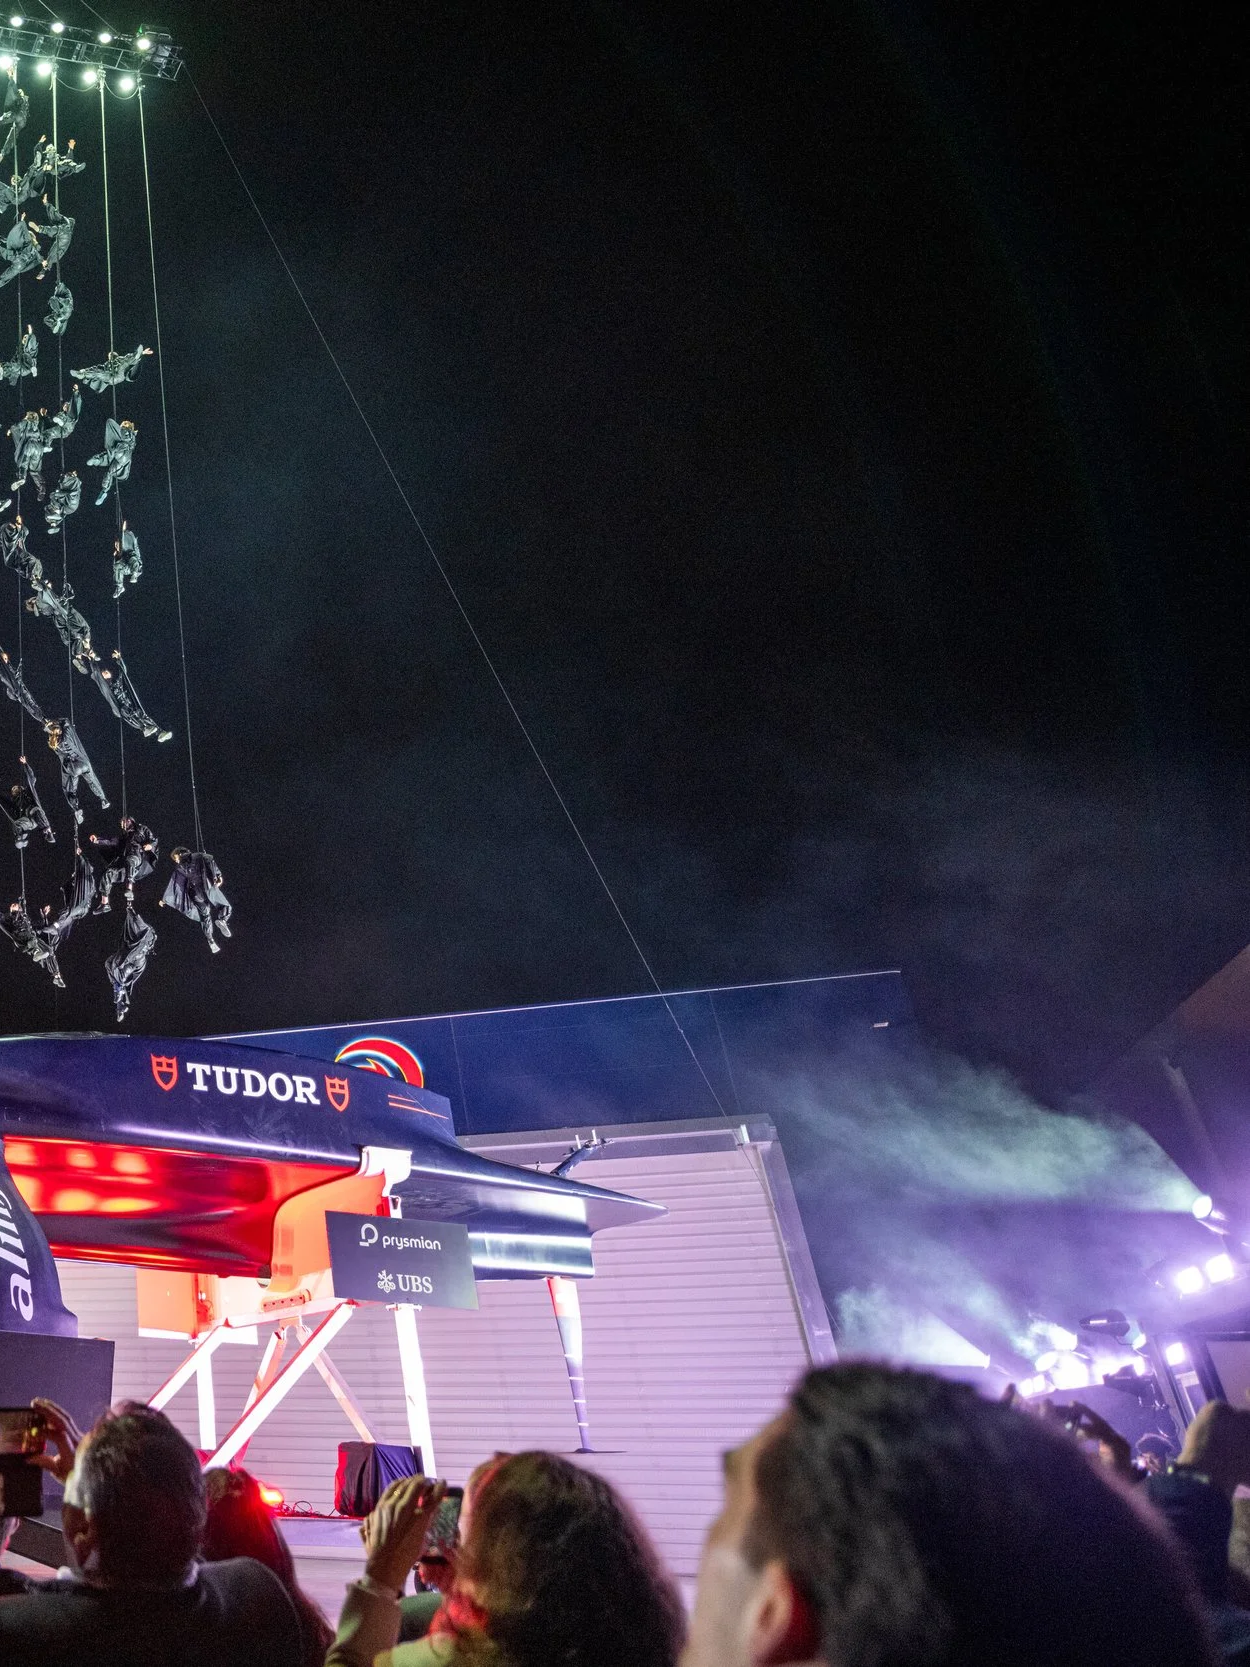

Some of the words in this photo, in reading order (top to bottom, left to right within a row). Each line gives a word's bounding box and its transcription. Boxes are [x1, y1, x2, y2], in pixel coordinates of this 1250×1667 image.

[187, 1062, 321, 1105] TUDOR
[382, 1235, 442, 1251] prysmian
[396, 1273, 433, 1294] UBS
